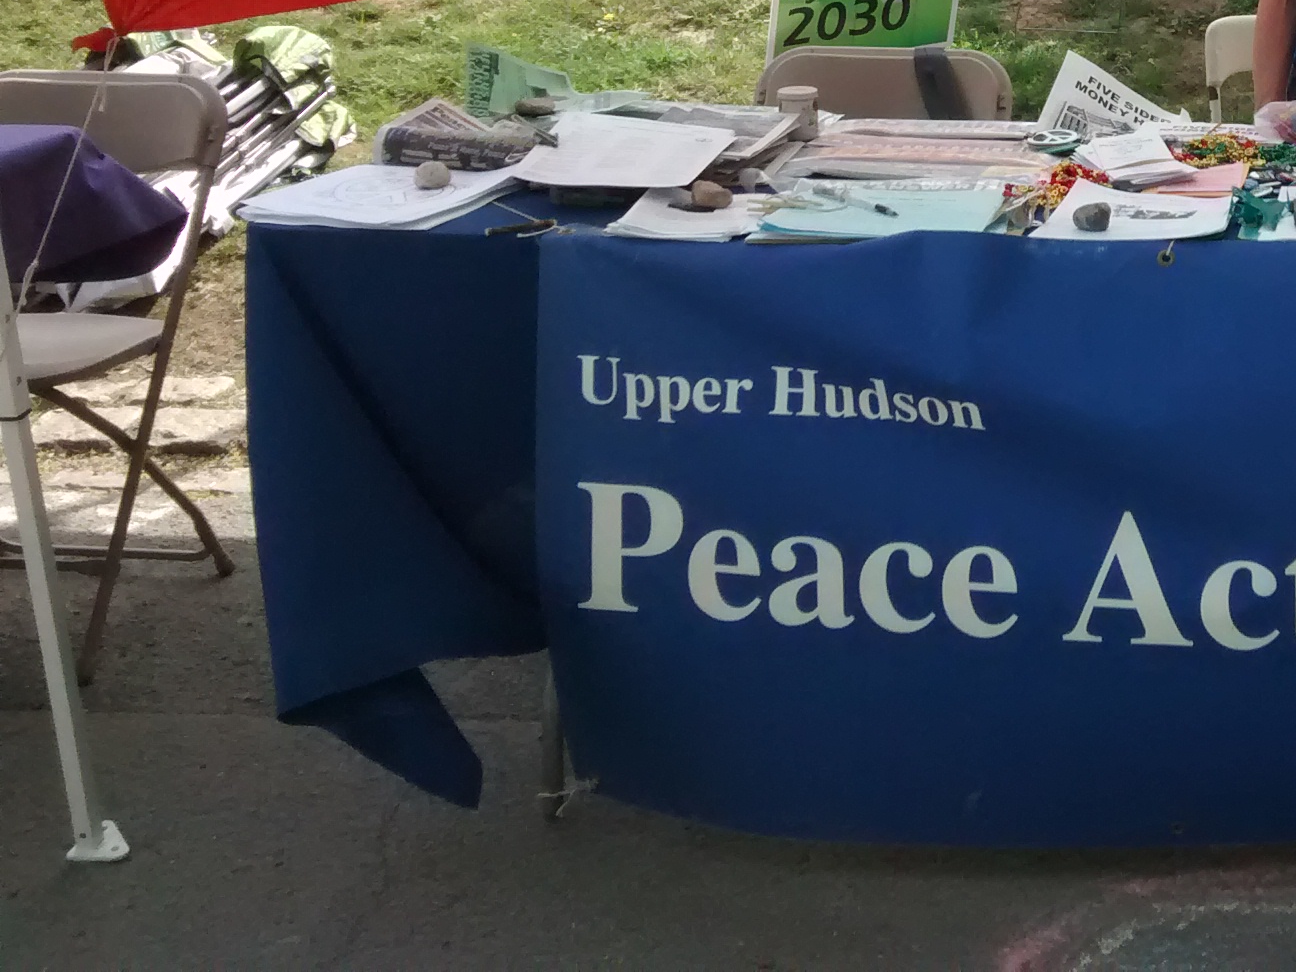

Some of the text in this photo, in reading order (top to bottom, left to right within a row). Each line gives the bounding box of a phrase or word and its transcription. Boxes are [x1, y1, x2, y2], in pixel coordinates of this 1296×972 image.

[1075, 80, 1129, 117] MONEY
[1087, 75, 1120, 103] FIVE
[576, 354, 987, 431] Upper Hudson
[577, 482, 1019, 639] Peace
